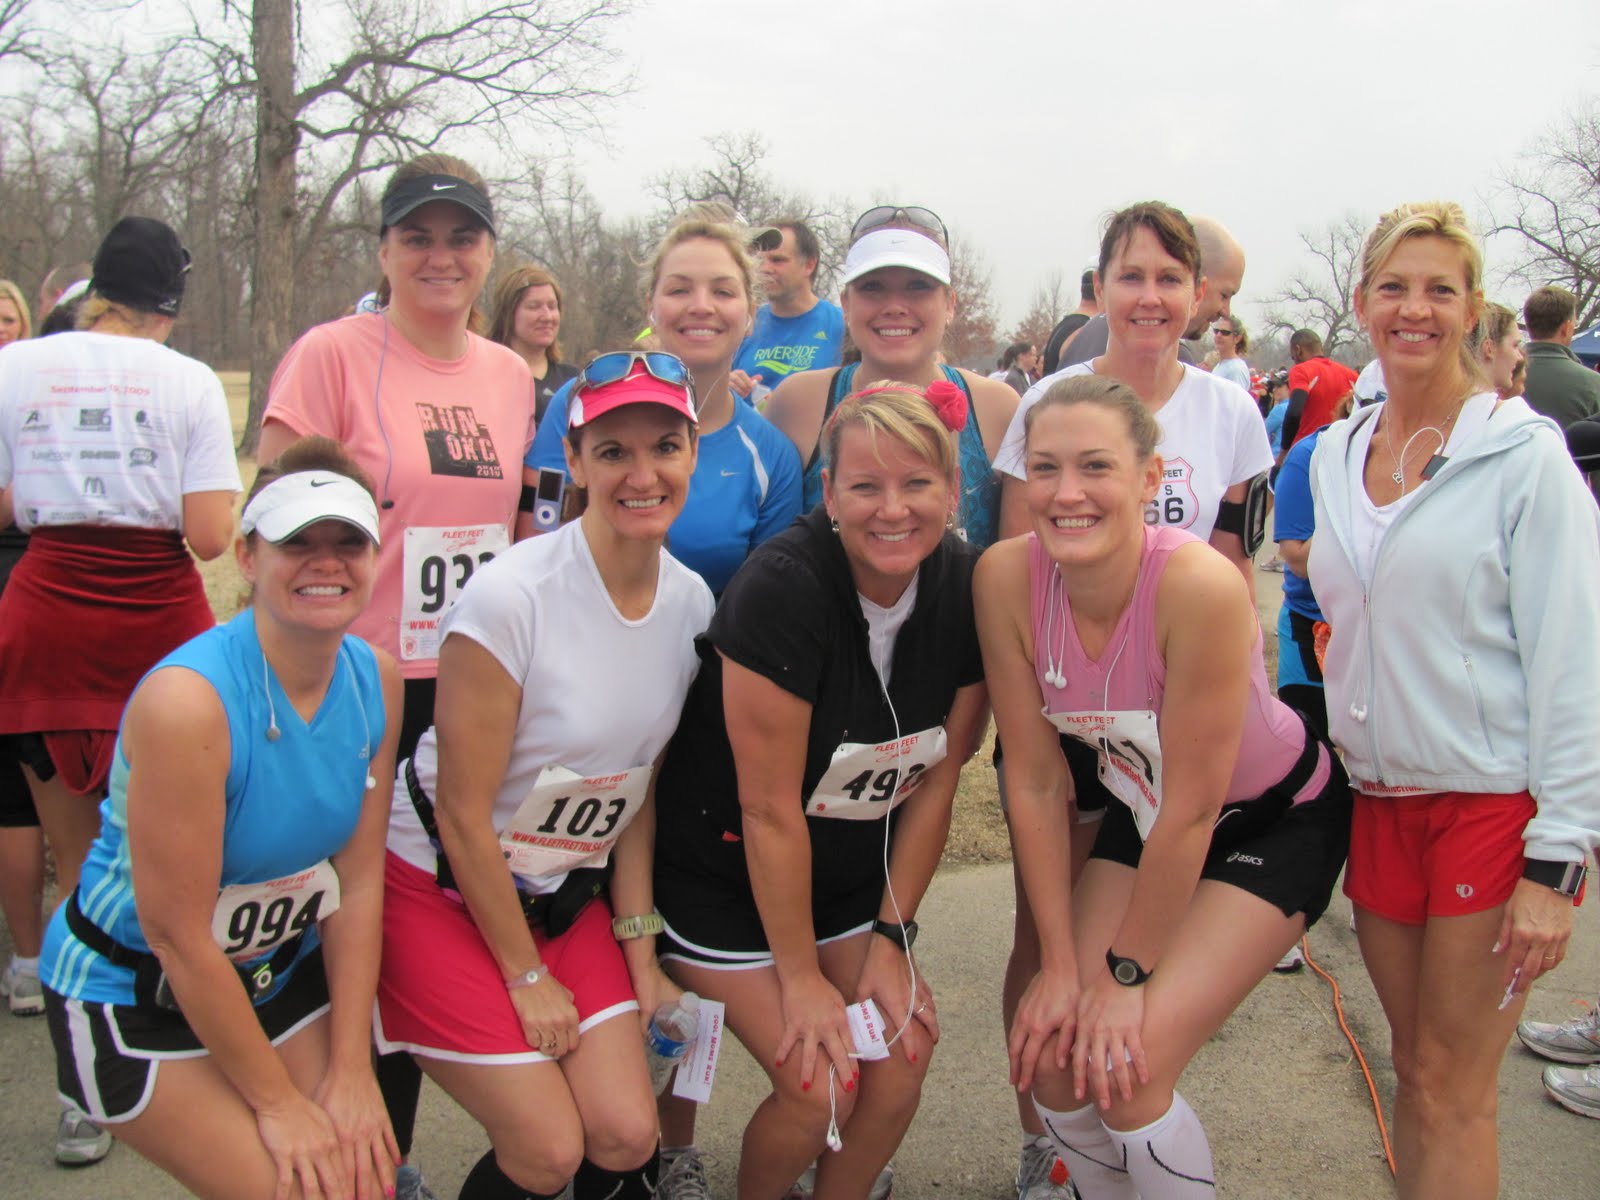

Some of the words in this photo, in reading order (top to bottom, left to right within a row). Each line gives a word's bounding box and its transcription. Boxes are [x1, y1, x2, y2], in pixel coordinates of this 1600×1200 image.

[753, 345, 820, 361] RIVERSIDE
[50, 385, 107, 395] September
[446, 434, 497, 462] OKC
[476, 465, 501, 478] 2010
[1162, 468, 1183, 478] FEET
[1164, 484, 1173, 496] S
[1144, 496, 1184, 526] 66
[442, 531, 467, 539] FLEET
[468, 529, 485, 538] FEET
[420, 551, 497, 614] 93
[1066, 715, 1093, 725] FLEET
[1094, 716, 1116, 725] FEET
[874, 742, 899, 752] FLEET
[900, 735, 920, 747] FEET
[583, 777, 610, 786] FLEET
[610, 773, 629, 785] FEET
[536, 796, 627, 838] 103
[224, 889, 326, 955] 994
[860, 1002, 871, 1021] OMS
[866, 1022, 880, 1044] RUN!
[708, 1036, 718, 1062] MOMS
